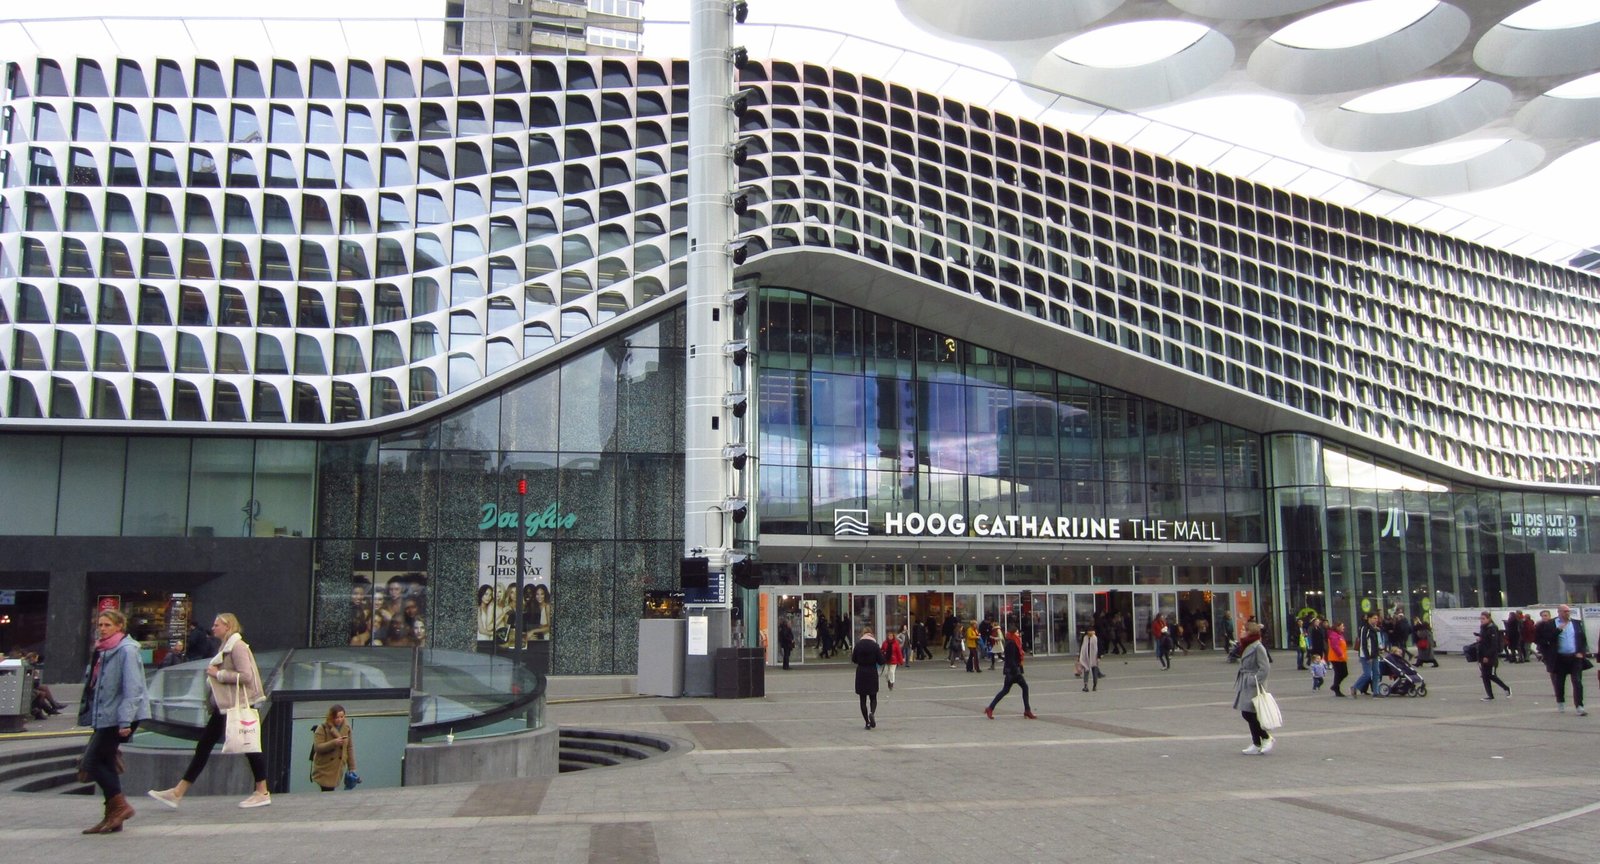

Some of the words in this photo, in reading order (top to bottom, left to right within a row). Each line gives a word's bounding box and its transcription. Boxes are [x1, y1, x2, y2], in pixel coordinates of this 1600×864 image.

[478, 502, 577, 537] Douglas
[885, 511, 966, 535] HOOG
[973, 513, 1121, 538] CATHARIJNE
[1128, 518, 1167, 540] THE
[1173, 520, 1222, 541] MALL
[1531, 528, 1541, 536] OF
[361, 551, 421, 561] BECCA
[499, 554, 533, 566] BON
[487, 565, 516, 576] THIS
